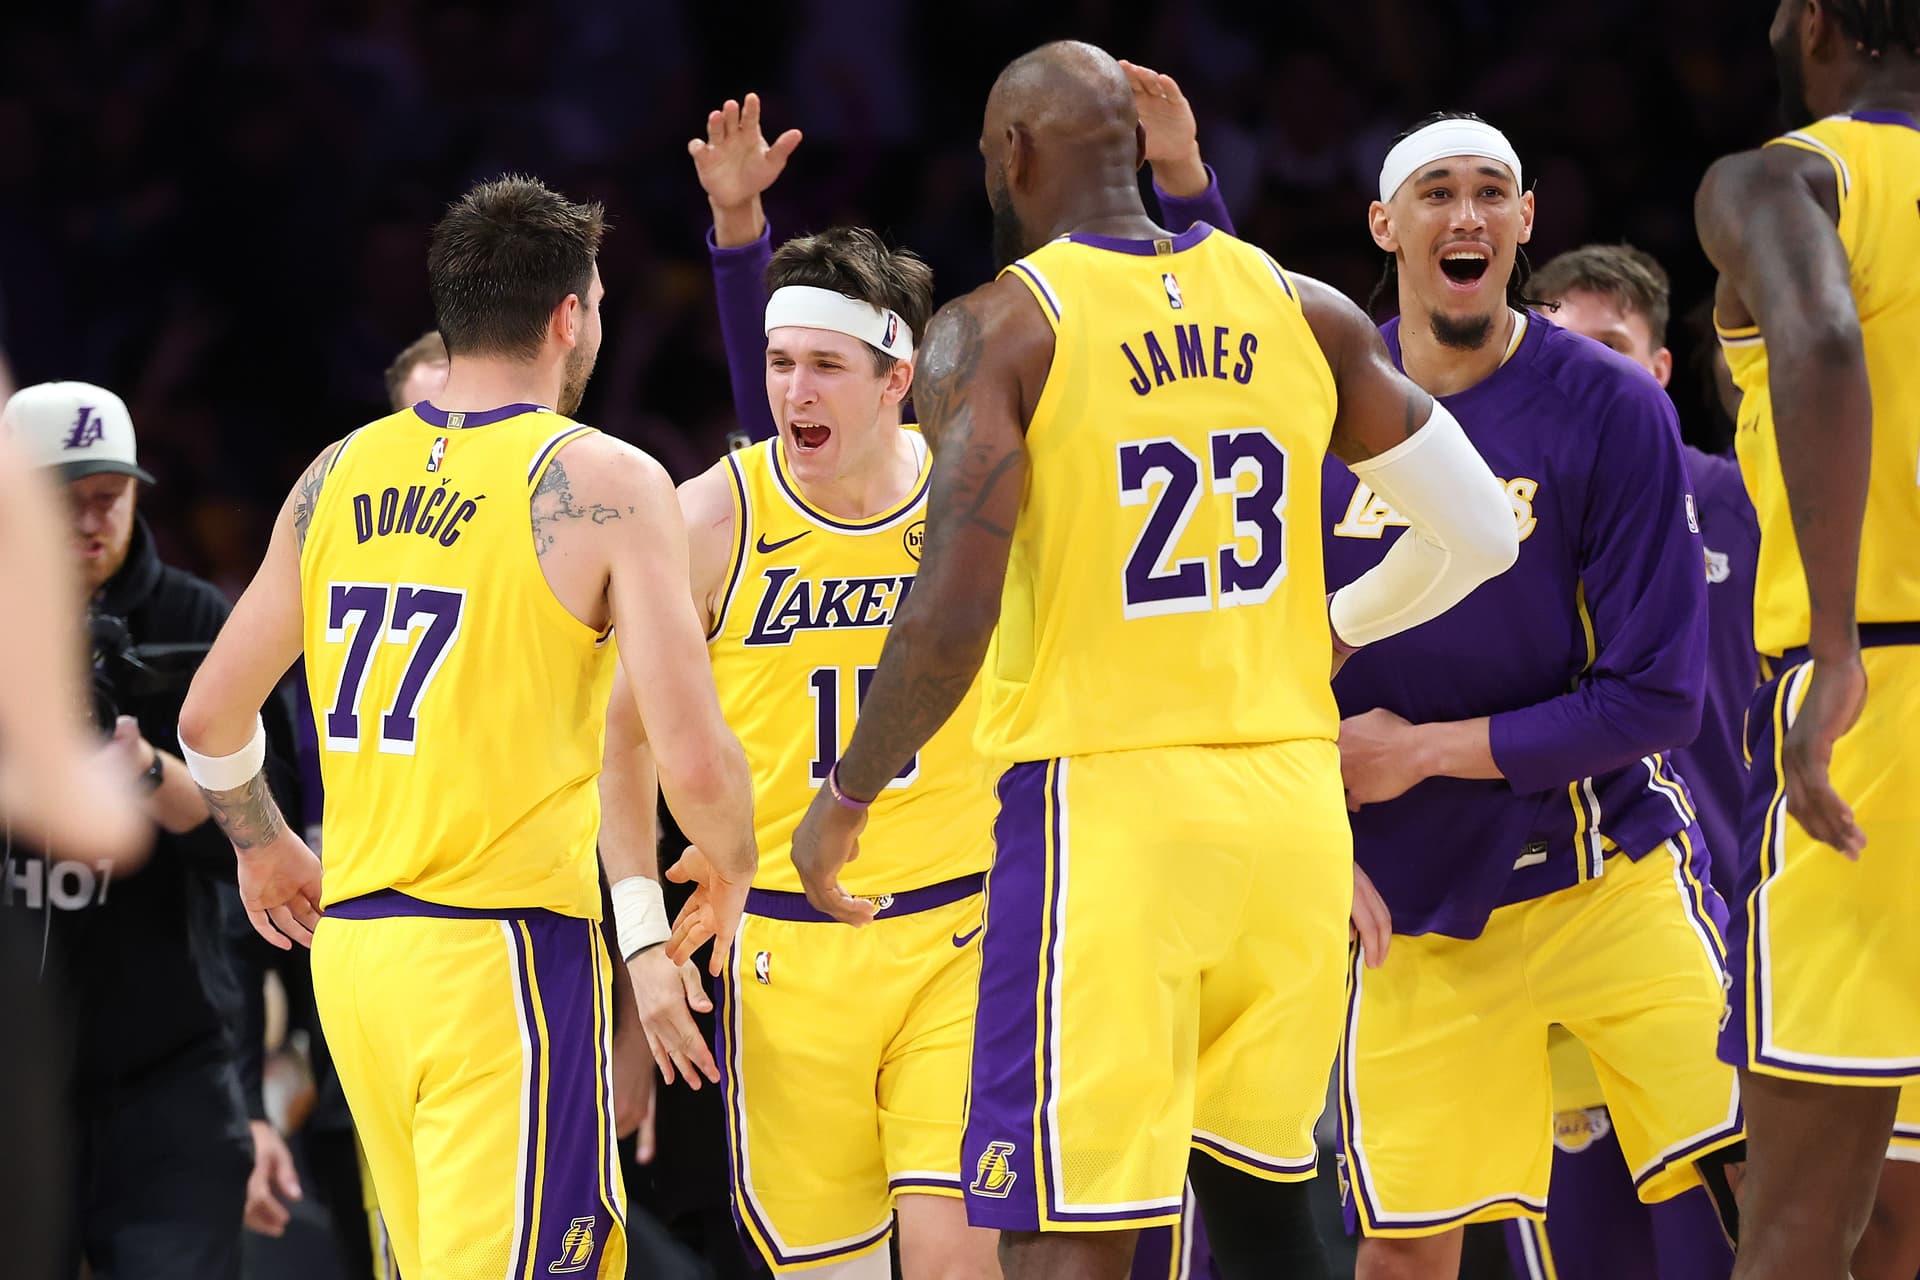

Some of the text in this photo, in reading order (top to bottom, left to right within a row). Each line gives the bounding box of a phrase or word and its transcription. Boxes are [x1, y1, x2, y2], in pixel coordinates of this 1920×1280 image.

[1120, 323, 1258, 396] JAMES
[353, 477, 486, 547] DONČIĆ
[1116, 427, 1289, 621] 23
[744, 565, 917, 647] LAKE
[324, 579, 467, 756] 77
